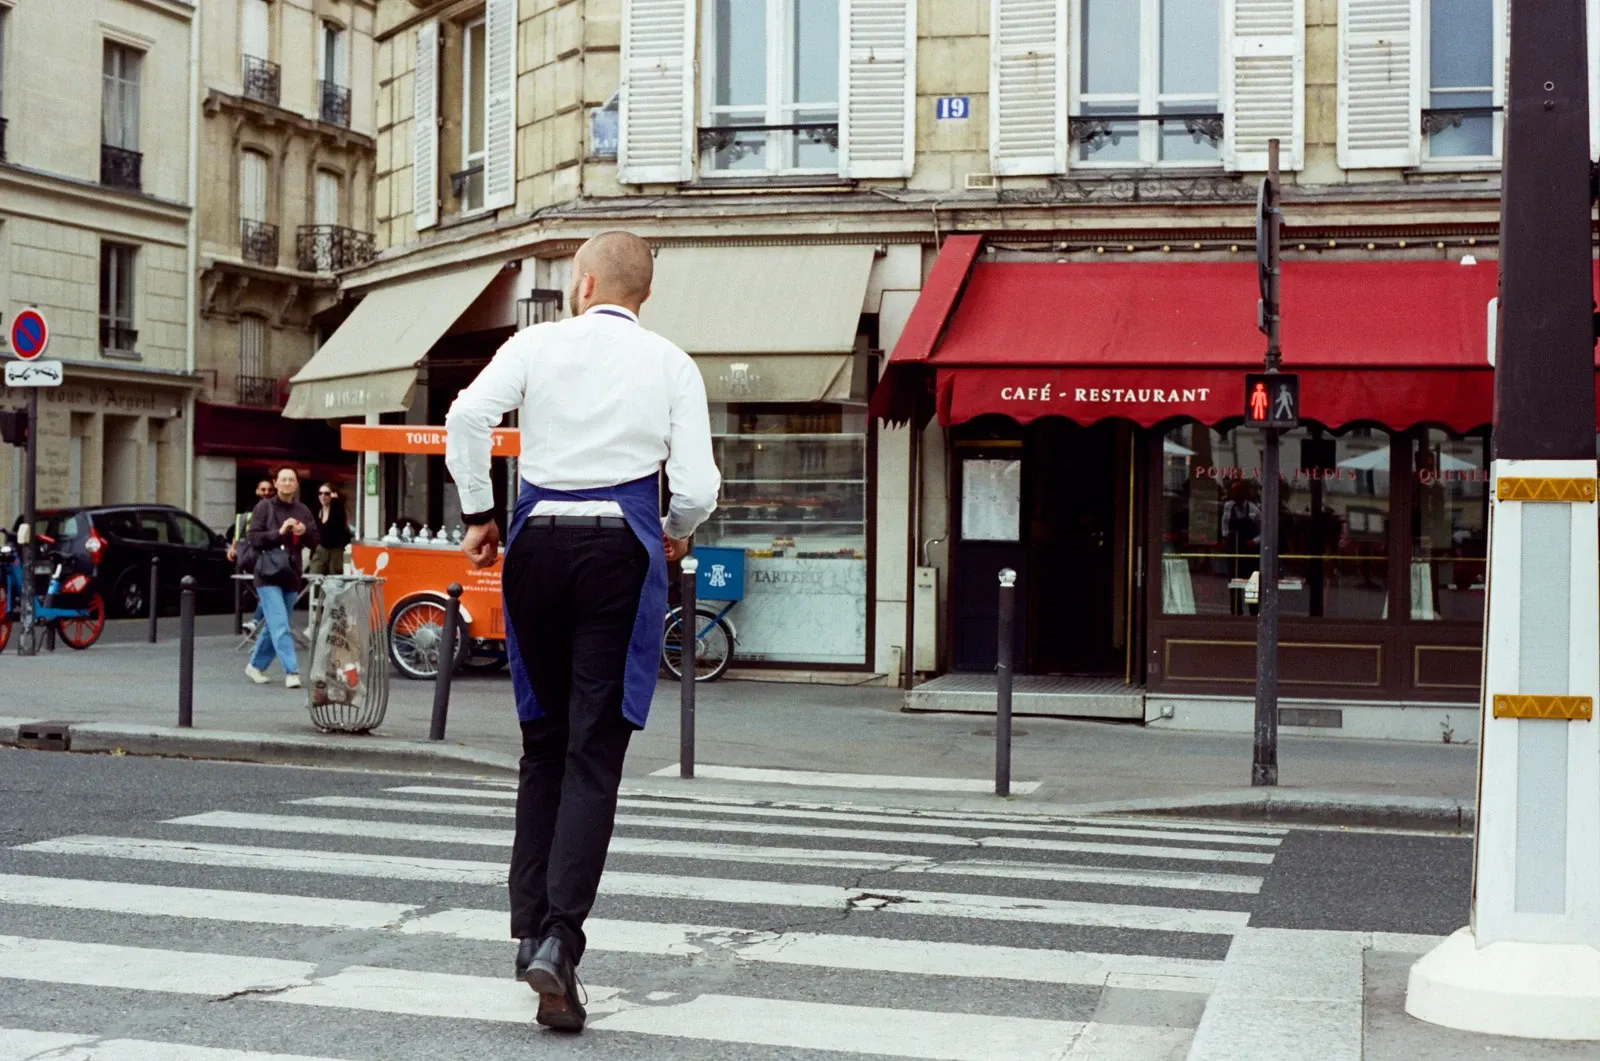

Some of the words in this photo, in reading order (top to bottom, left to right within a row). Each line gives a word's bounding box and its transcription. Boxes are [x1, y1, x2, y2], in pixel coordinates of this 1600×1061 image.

[942, 98, 964, 117] 19
[1001, 384, 1051, 401] CAFÉ
[1075, 388, 1209, 402] RESTAURANT
[406, 433, 440, 444] TOUR
[1195, 466, 1282, 479] POIREA
